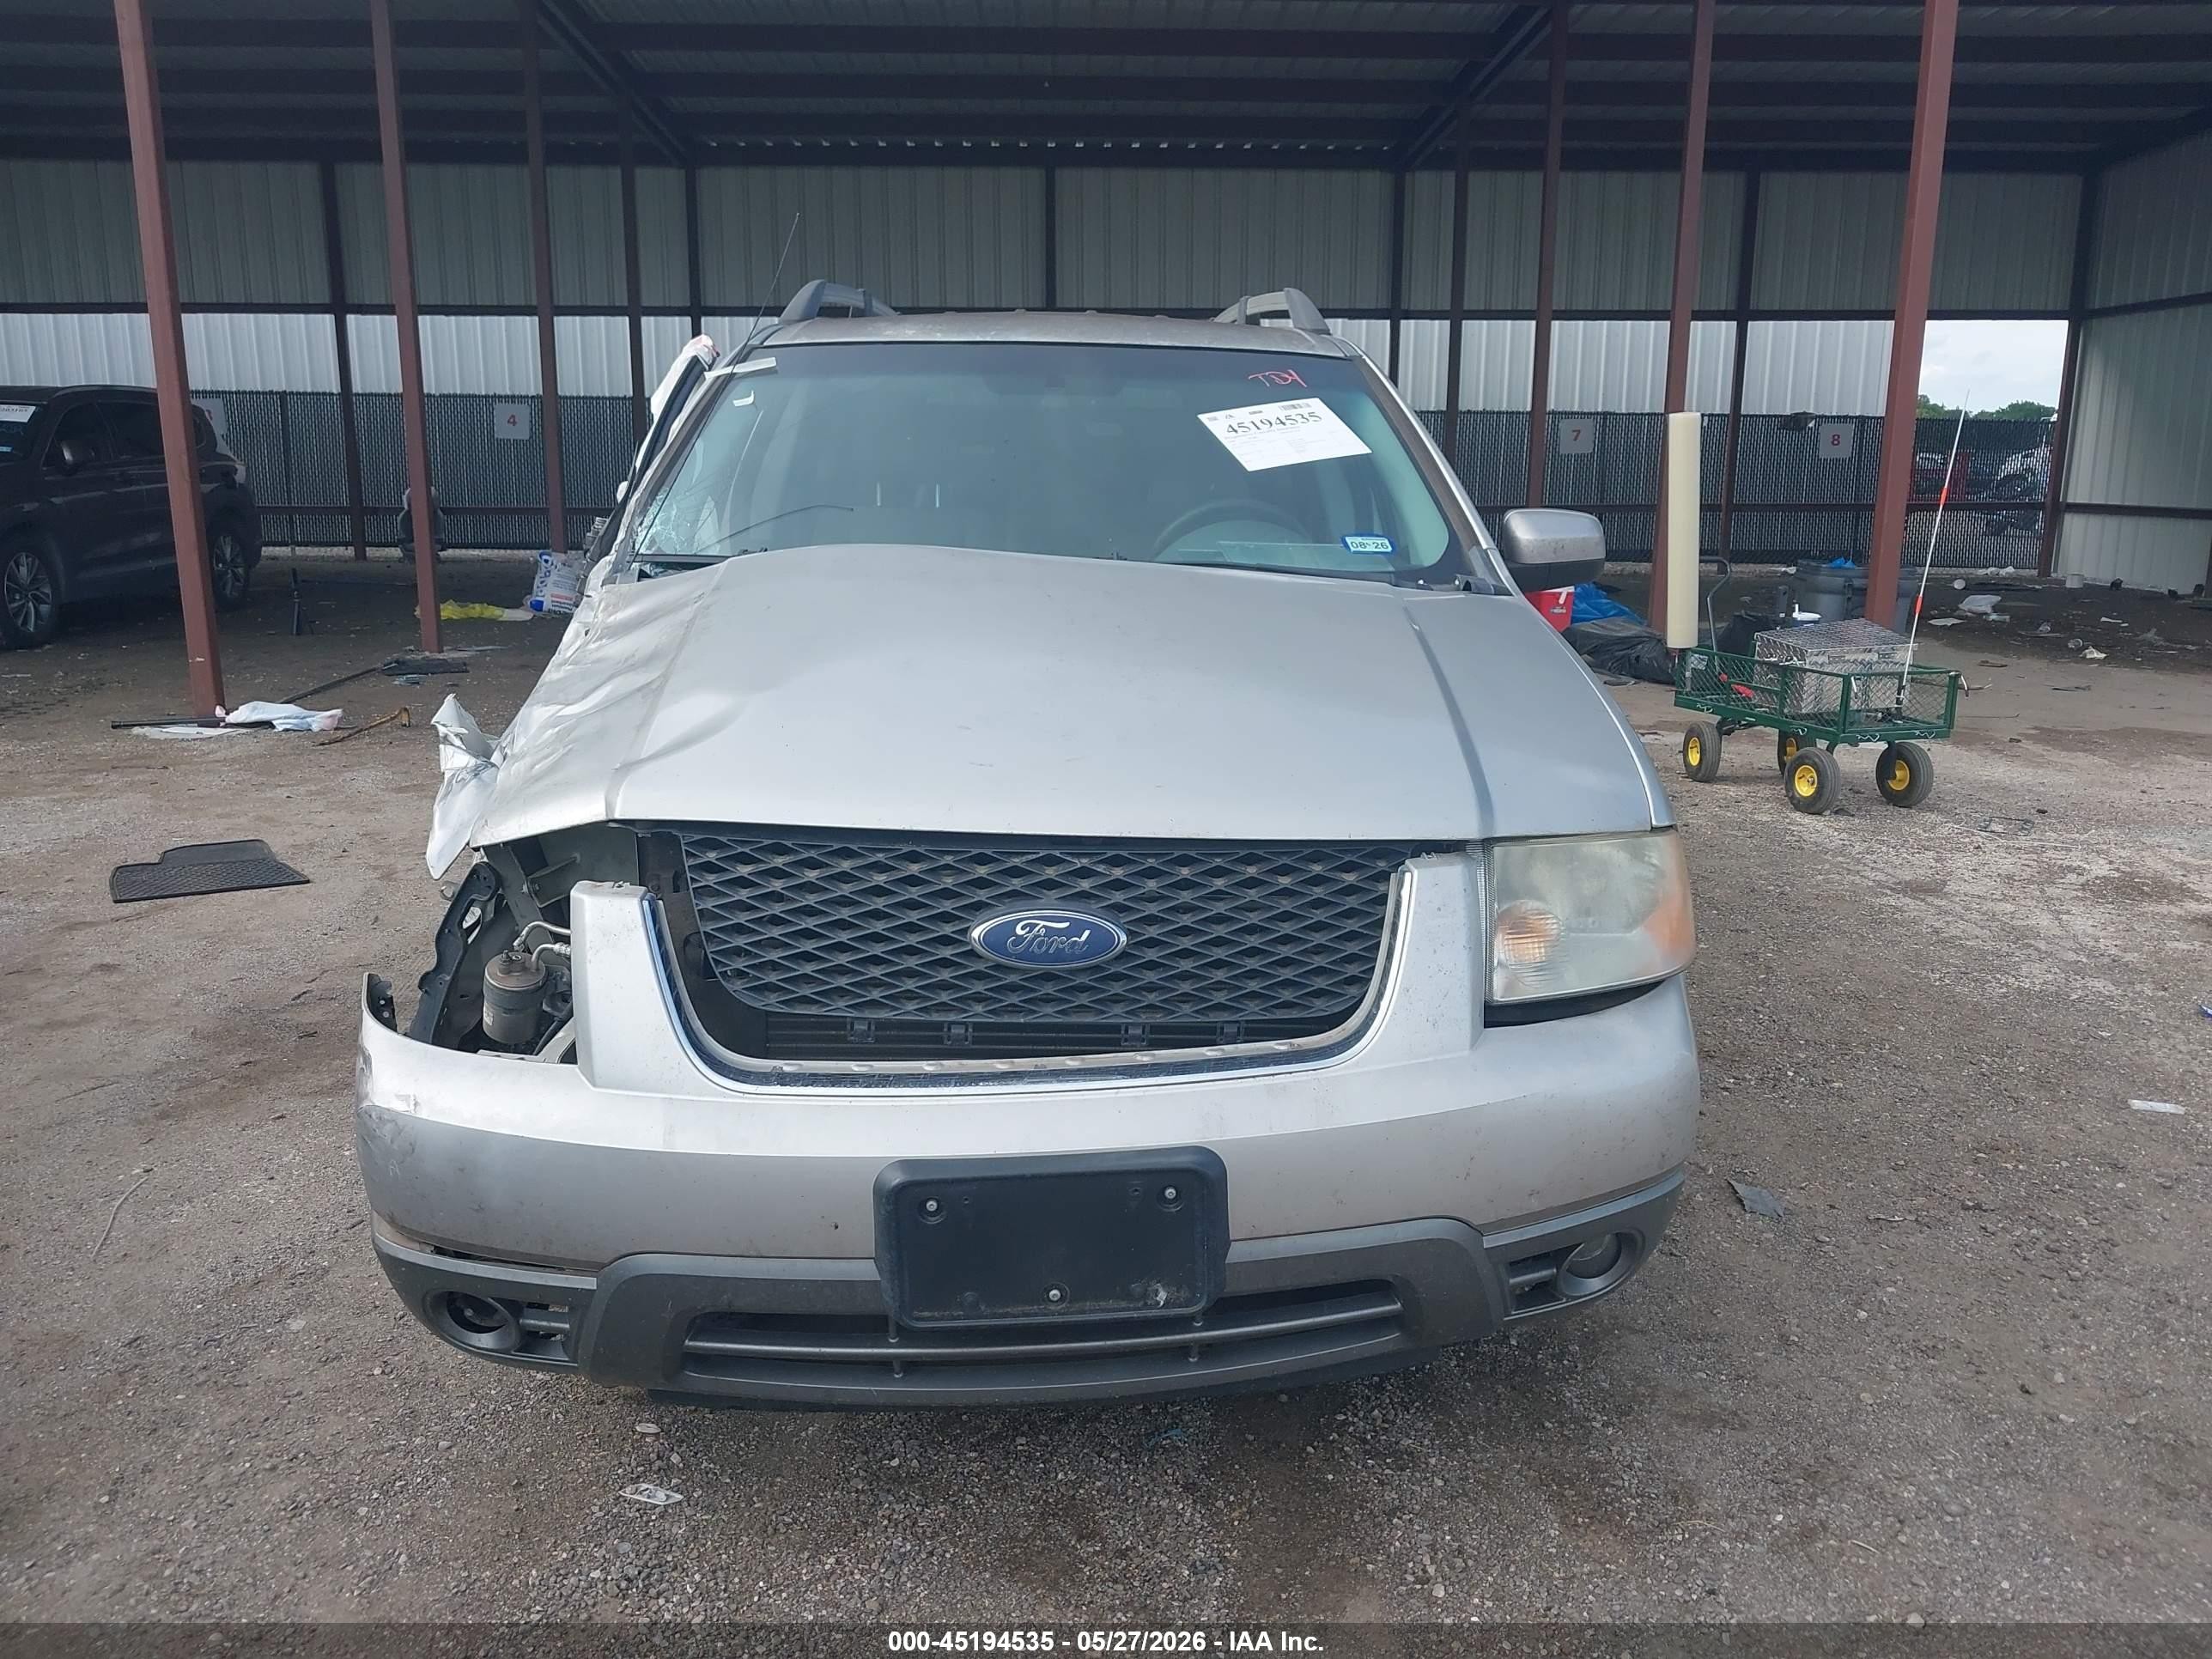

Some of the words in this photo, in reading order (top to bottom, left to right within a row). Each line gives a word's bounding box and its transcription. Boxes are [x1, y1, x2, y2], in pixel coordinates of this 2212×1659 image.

[507, 414, 518, 427] 4
[1226, 411, 1322, 434] 45194535
[1571, 429, 1582, 441] 7
[1831, 434, 1841, 447] 8
[1350, 541, 1368, 550] 08
[1372, 541, 1389, 550] 26
[1006, 919, 1091, 955] Ford
